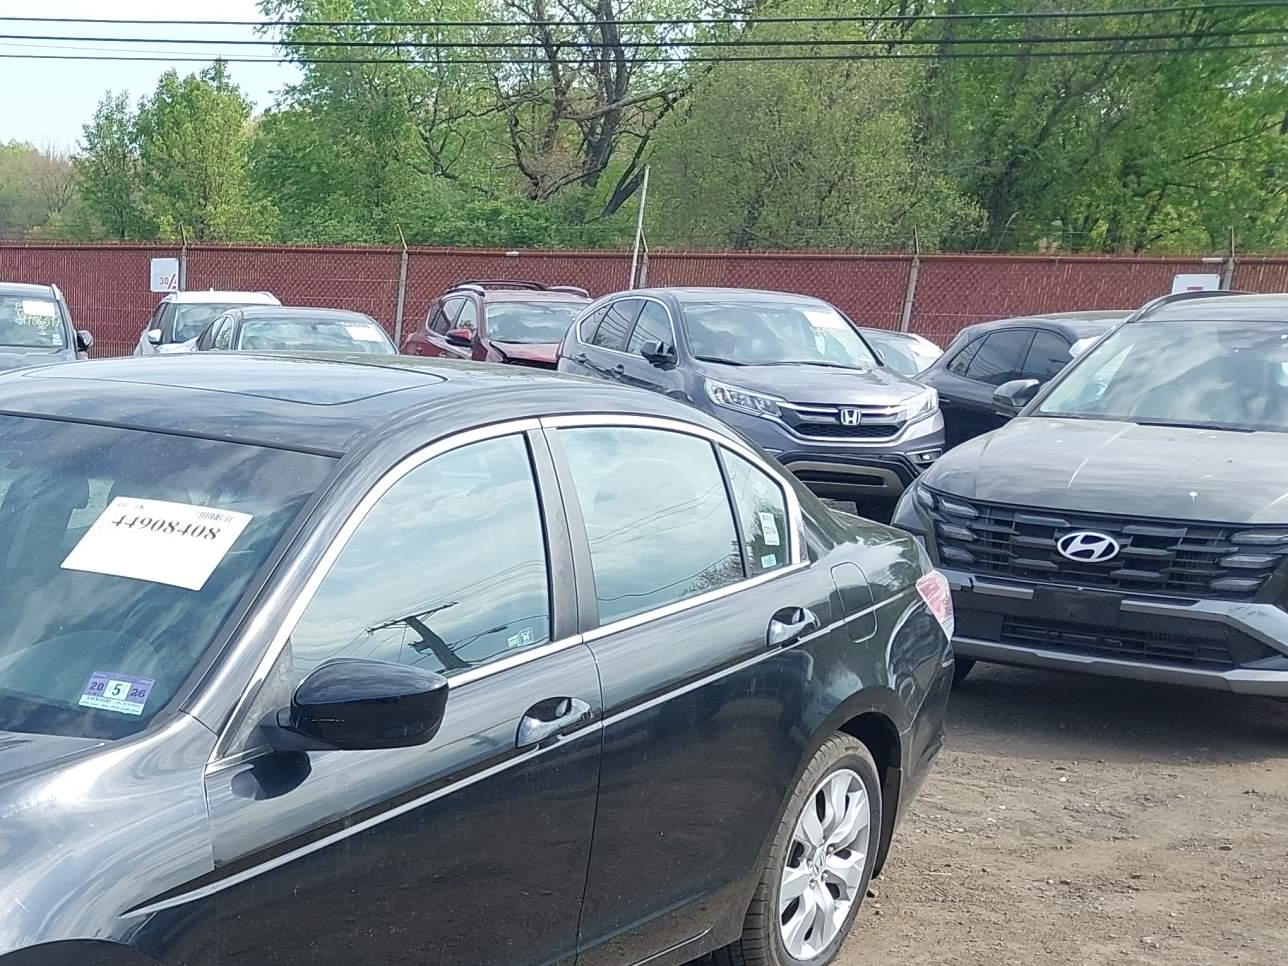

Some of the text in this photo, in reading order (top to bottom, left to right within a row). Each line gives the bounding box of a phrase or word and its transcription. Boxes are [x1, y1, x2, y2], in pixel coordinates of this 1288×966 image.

[112, 514, 221, 540] 44908408
[89, 682, 146, 698] 20 5 26
